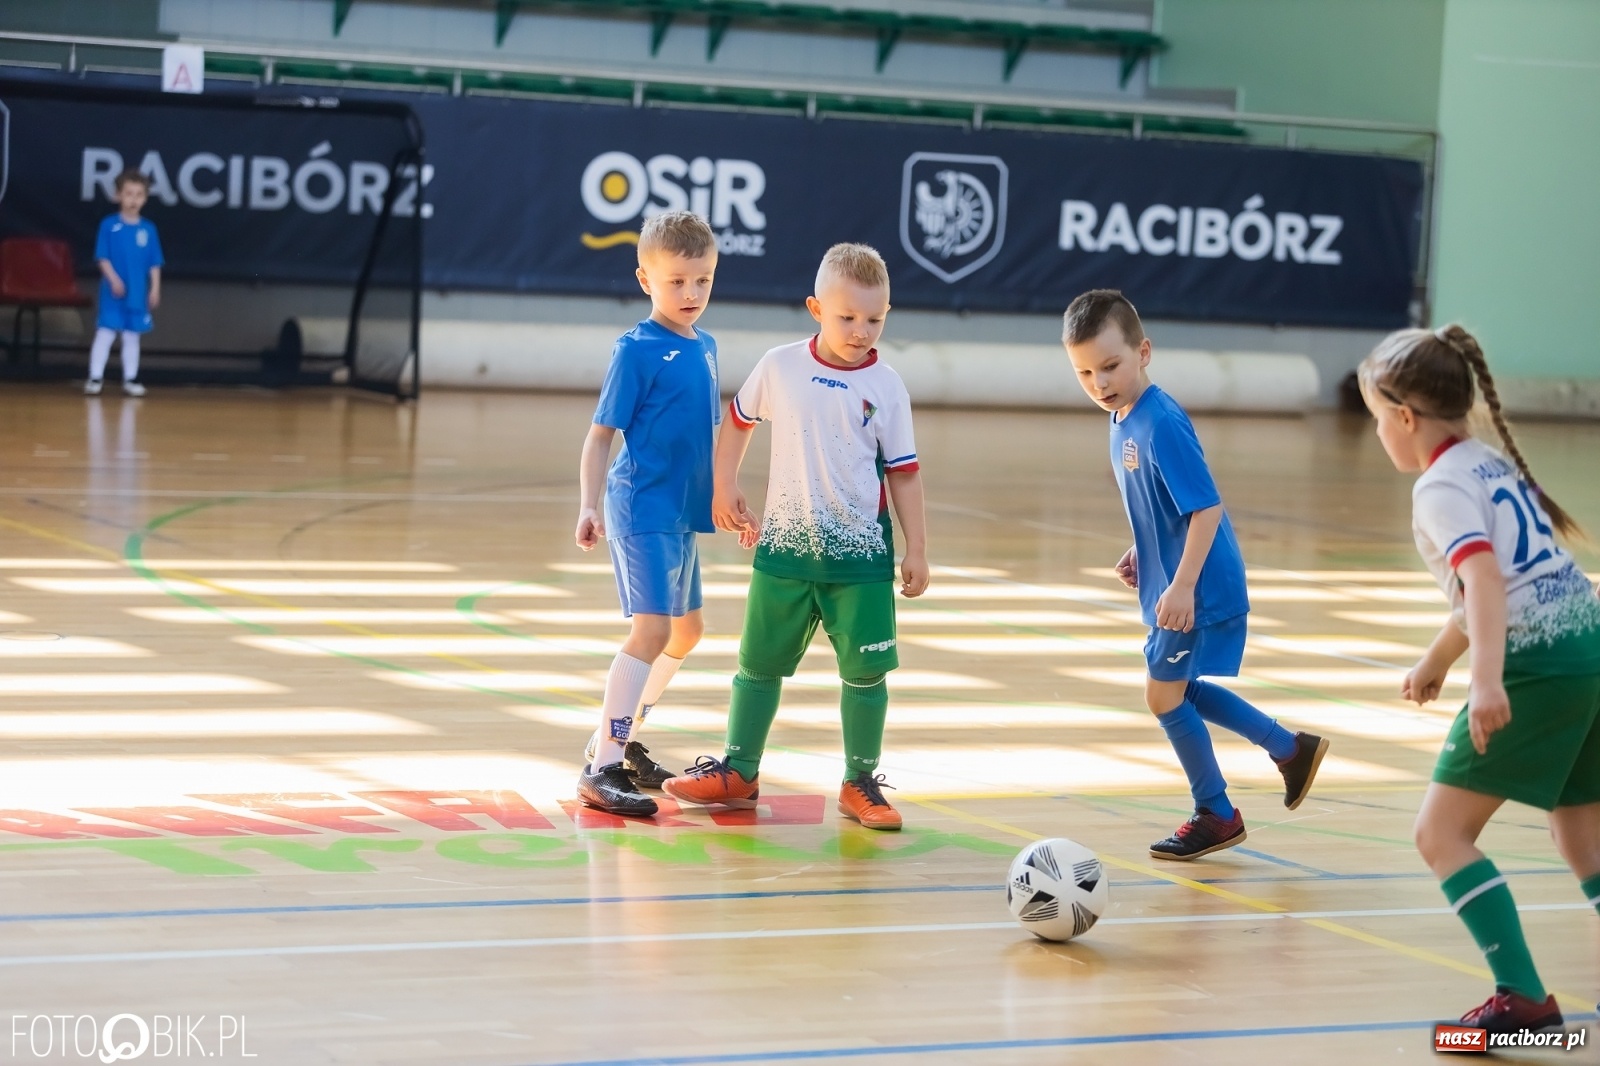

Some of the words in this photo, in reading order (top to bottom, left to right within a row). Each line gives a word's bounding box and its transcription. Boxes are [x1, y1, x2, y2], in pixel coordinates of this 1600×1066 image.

[1058, 194, 1343, 265] RACIBÓRZ
[811, 376, 848, 390] regio
[859, 639, 896, 654] regio
